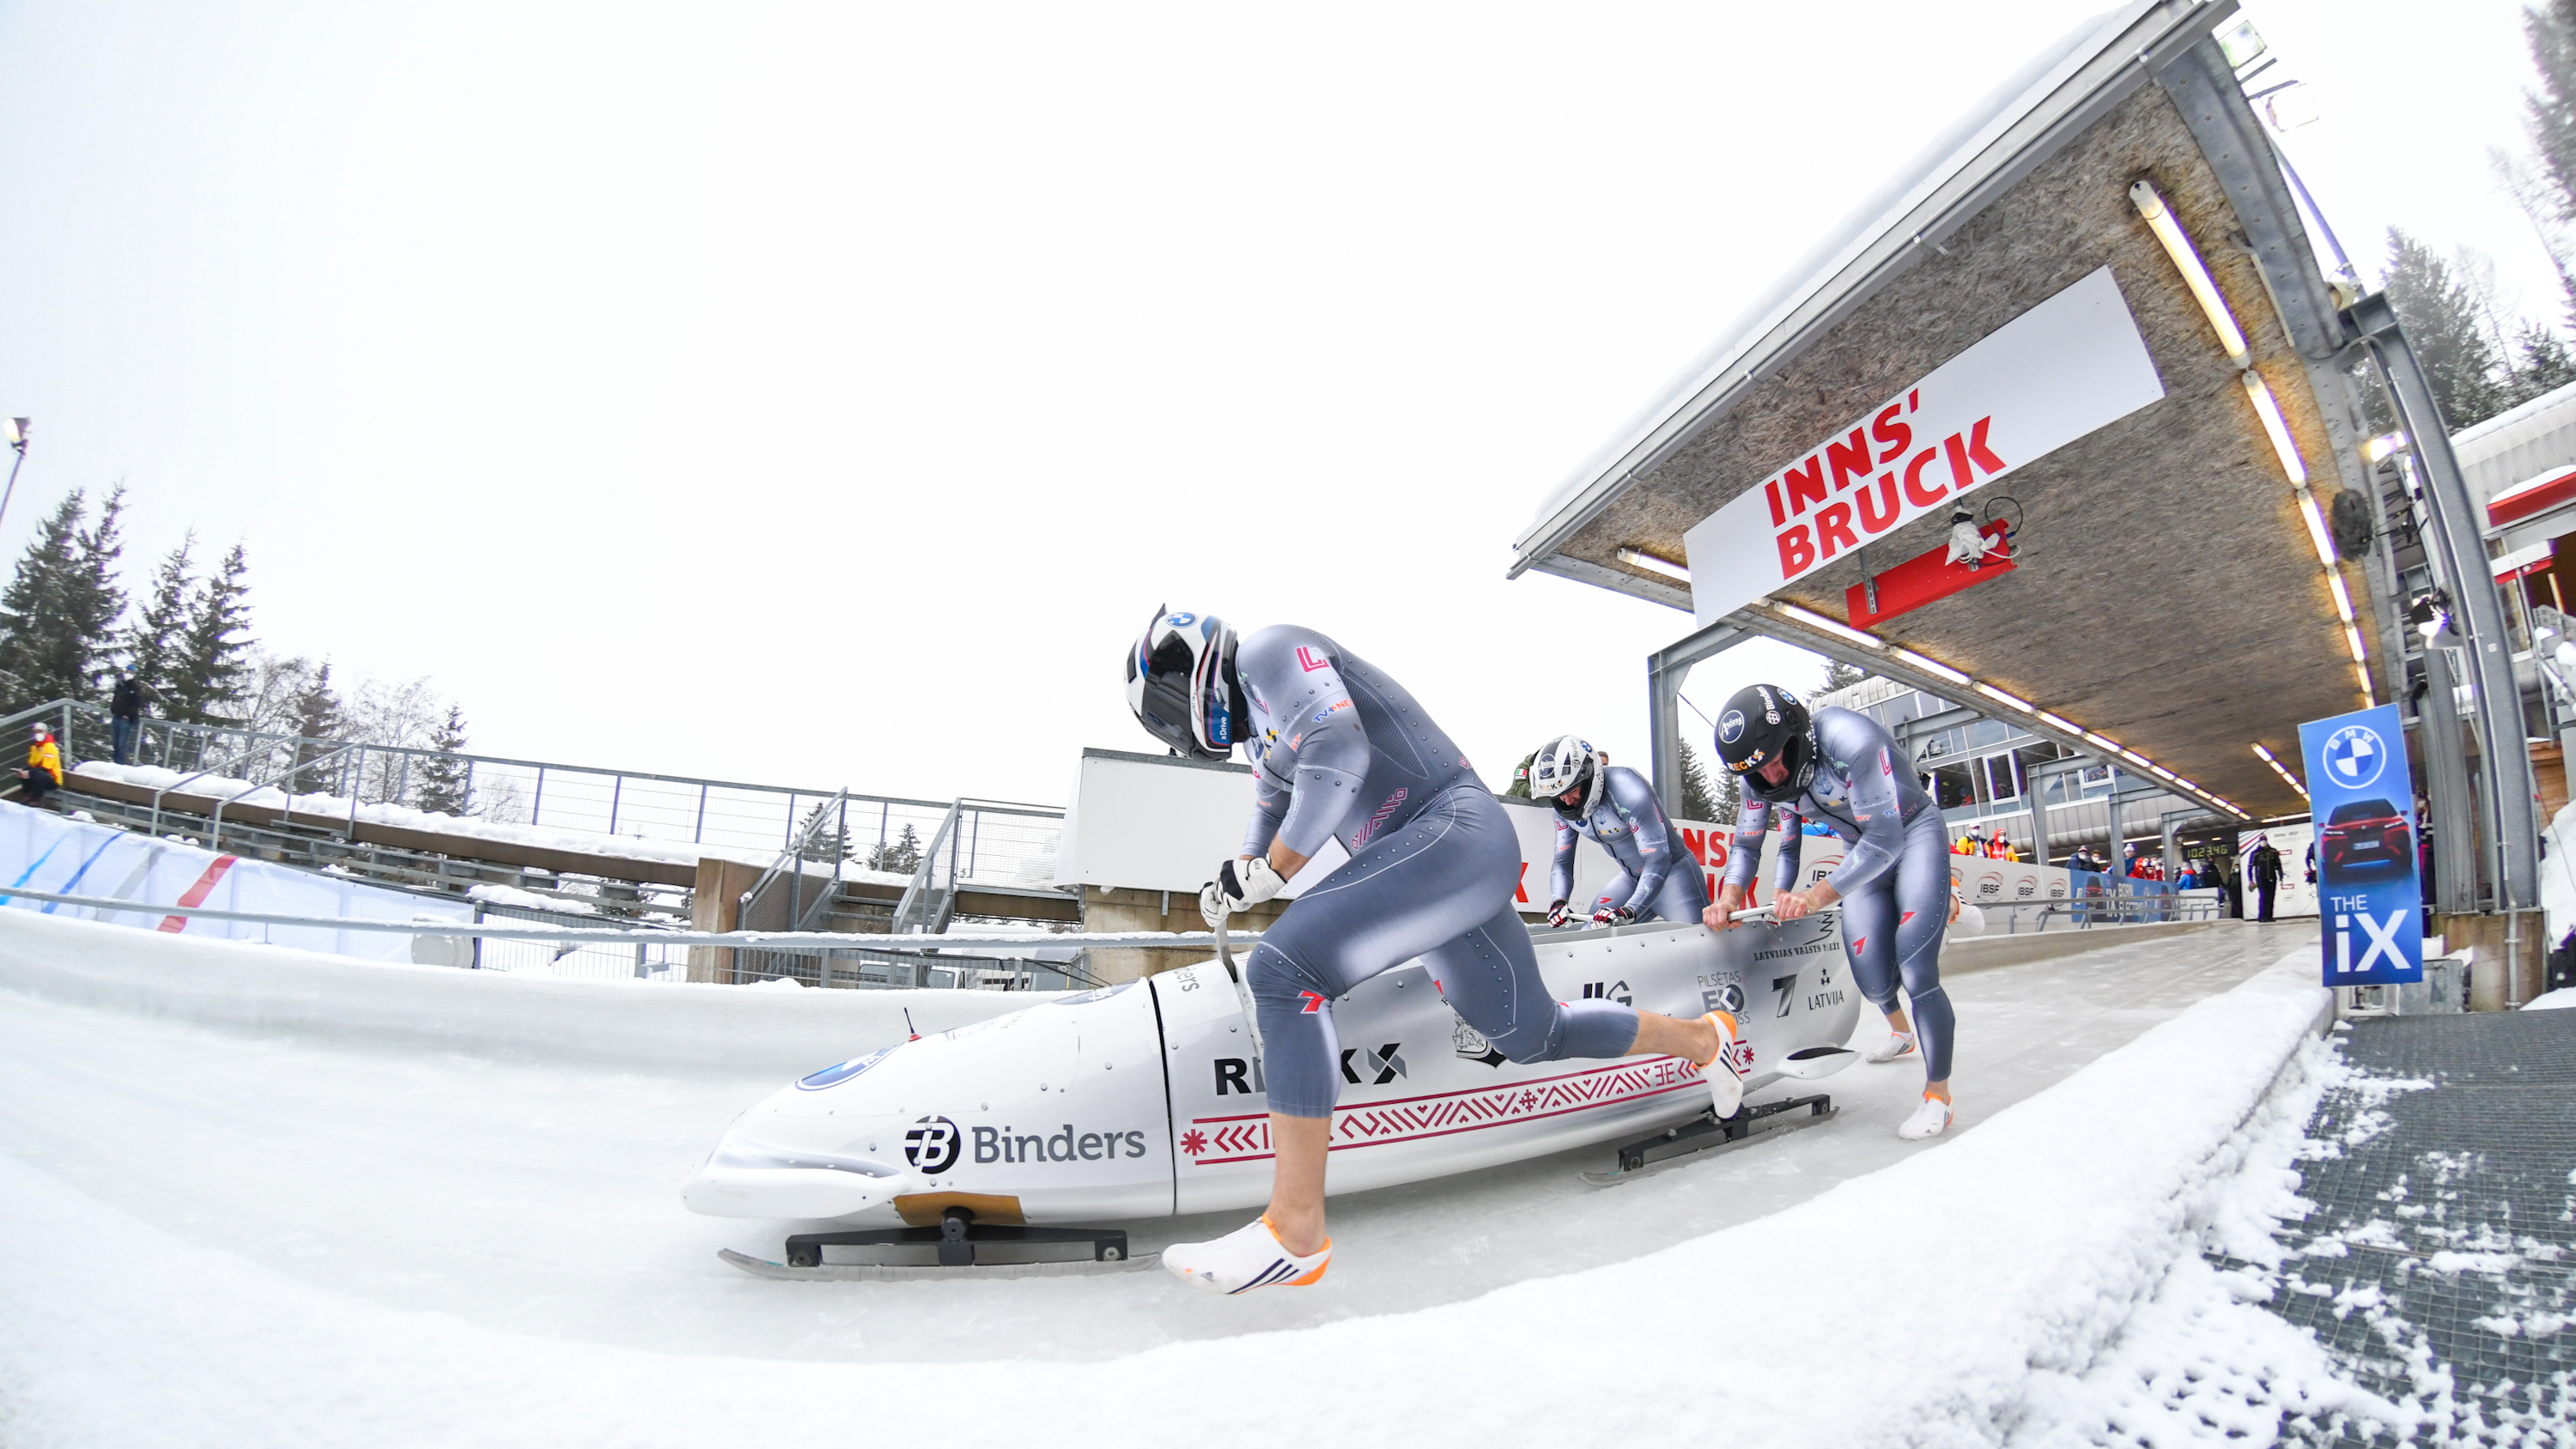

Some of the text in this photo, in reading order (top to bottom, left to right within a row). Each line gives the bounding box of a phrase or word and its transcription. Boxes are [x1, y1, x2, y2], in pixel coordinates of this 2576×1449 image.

[1764, 387, 1918, 527] INNS'
[1777, 415, 2006, 579] BRUCK
[1219, 716, 1228, 741] xDrive
[2329, 729, 2376, 750] BMW
[1979, 883, 2000, 894] IBSF
[2018, 887, 2034, 896] IBSF
[2330, 894, 2368, 912] THE
[2335, 909, 2412, 973] iX
[1753, 948, 1793, 961] LATVIJAS
[1793, 944, 1821, 955] VALSTS
[1697, 970, 1741, 988] PILSĒTAS
[1807, 989, 1844, 1011] LATVIJA
[971, 1124, 1146, 1164] Binders
